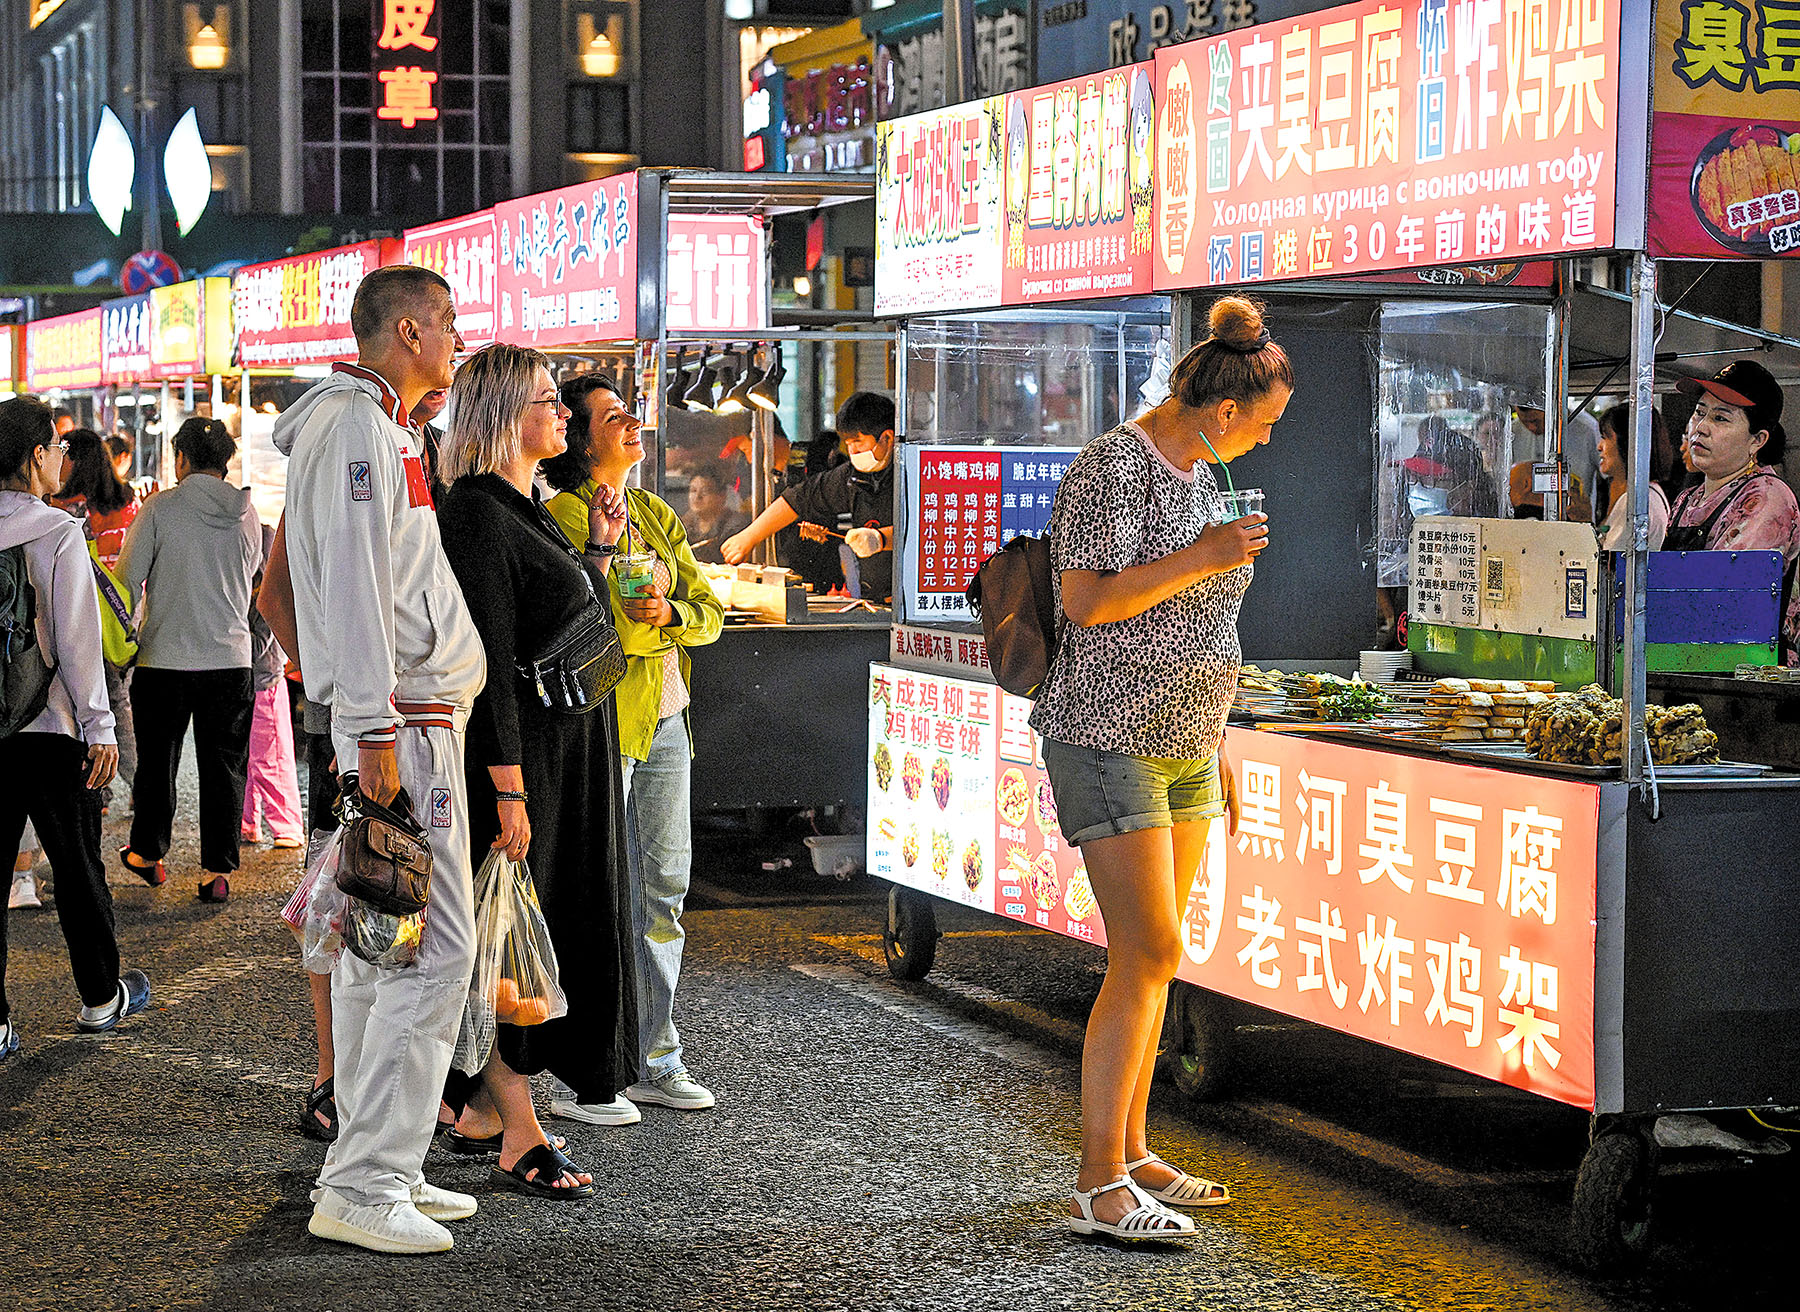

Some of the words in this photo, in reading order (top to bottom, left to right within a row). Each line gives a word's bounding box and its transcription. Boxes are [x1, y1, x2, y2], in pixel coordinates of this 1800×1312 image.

[377, 0, 439, 129] 皮草
[1416, 0, 1448, 164] 怀旧
[1453, 0, 1606, 154] 炸鸡架
[1674, 0, 1800, 93] 臭豆
[1208, 40, 1233, 193] 冷面
[1237, 5, 1403, 188] 夹臭豆腐
[894, 115, 982, 248] 大成鸡柳王
[1166, 81, 1190, 258] 嗷嗷香
[1212, 194, 1306, 228] Холодная
[1312, 184, 1390, 223] курица
[1396, 181, 1408, 204] с
[1414, 163, 1530, 202] вонючим
[1537, 146, 1604, 190] тофу
[1054, 279, 1063, 293] со
[1063, 269, 1092, 292] свиной
[1093, 266, 1133, 293] вырезкой
[922, 461, 999, 481] 小馋嘴鸡柳
[1459, 557, 1476, 568] 10元
[1459, 569, 1475, 580] 10元
[1462, 594, 1475, 605] 5元
[1462, 606, 1475, 617] 5元
[873, 674, 989, 722] 大成鸡柳王
[885, 711, 981, 756] 鸡柳卷饼
[1235, 759, 1564, 926] 黑河臭豆腐
[1235, 885, 1563, 1071] 老式炸鸡架
